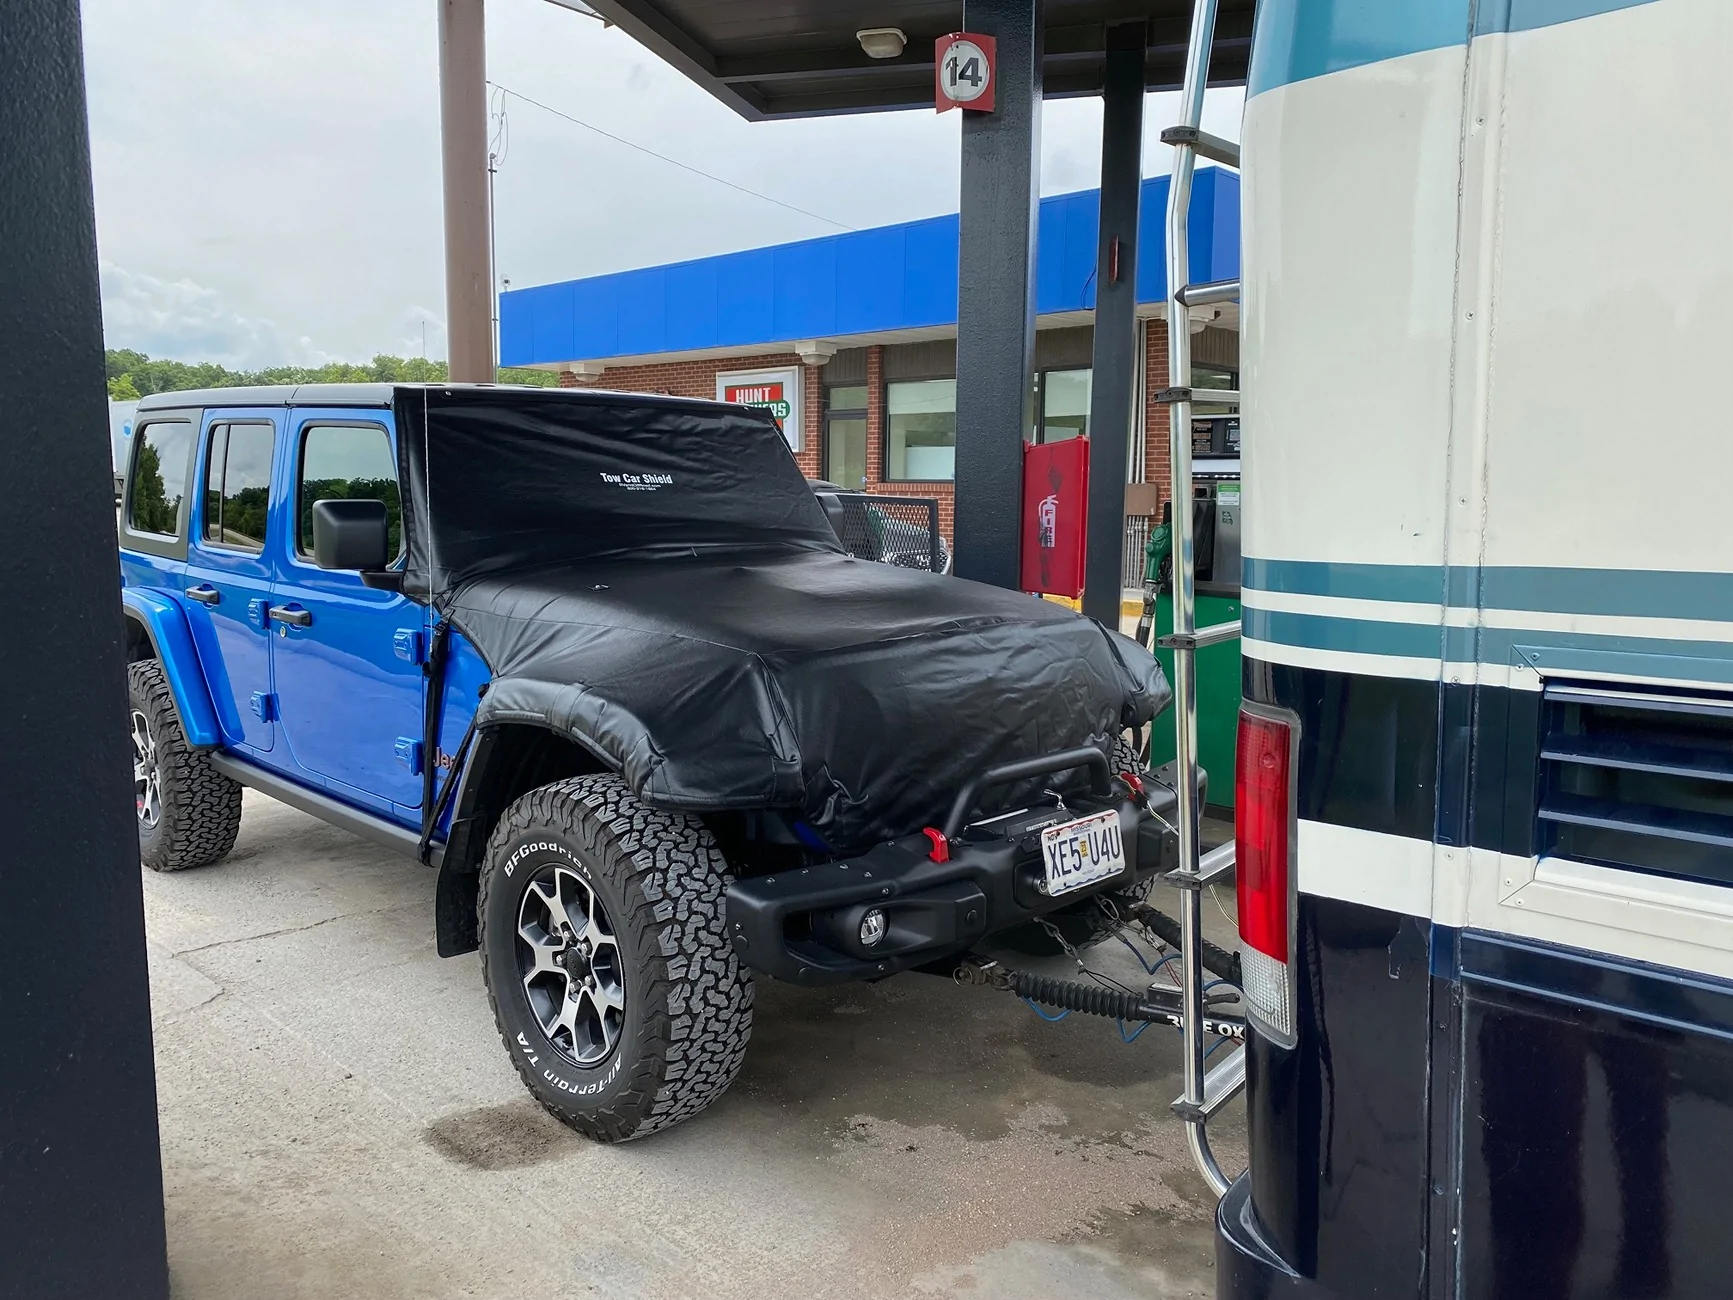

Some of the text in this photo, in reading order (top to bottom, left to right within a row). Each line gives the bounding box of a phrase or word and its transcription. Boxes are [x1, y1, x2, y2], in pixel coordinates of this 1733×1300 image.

[945, 56, 982, 87] 14
[735, 388, 771, 404] HUNT
[600, 472, 673, 484] Tow Car Shield
[504, 842, 592, 878] BFGoodrich
[1048, 825, 1120, 880] XE5 U4U
[1218, 1023, 1245, 1039] OX
[516, 1031, 621, 1095] All-Terrain T/A
